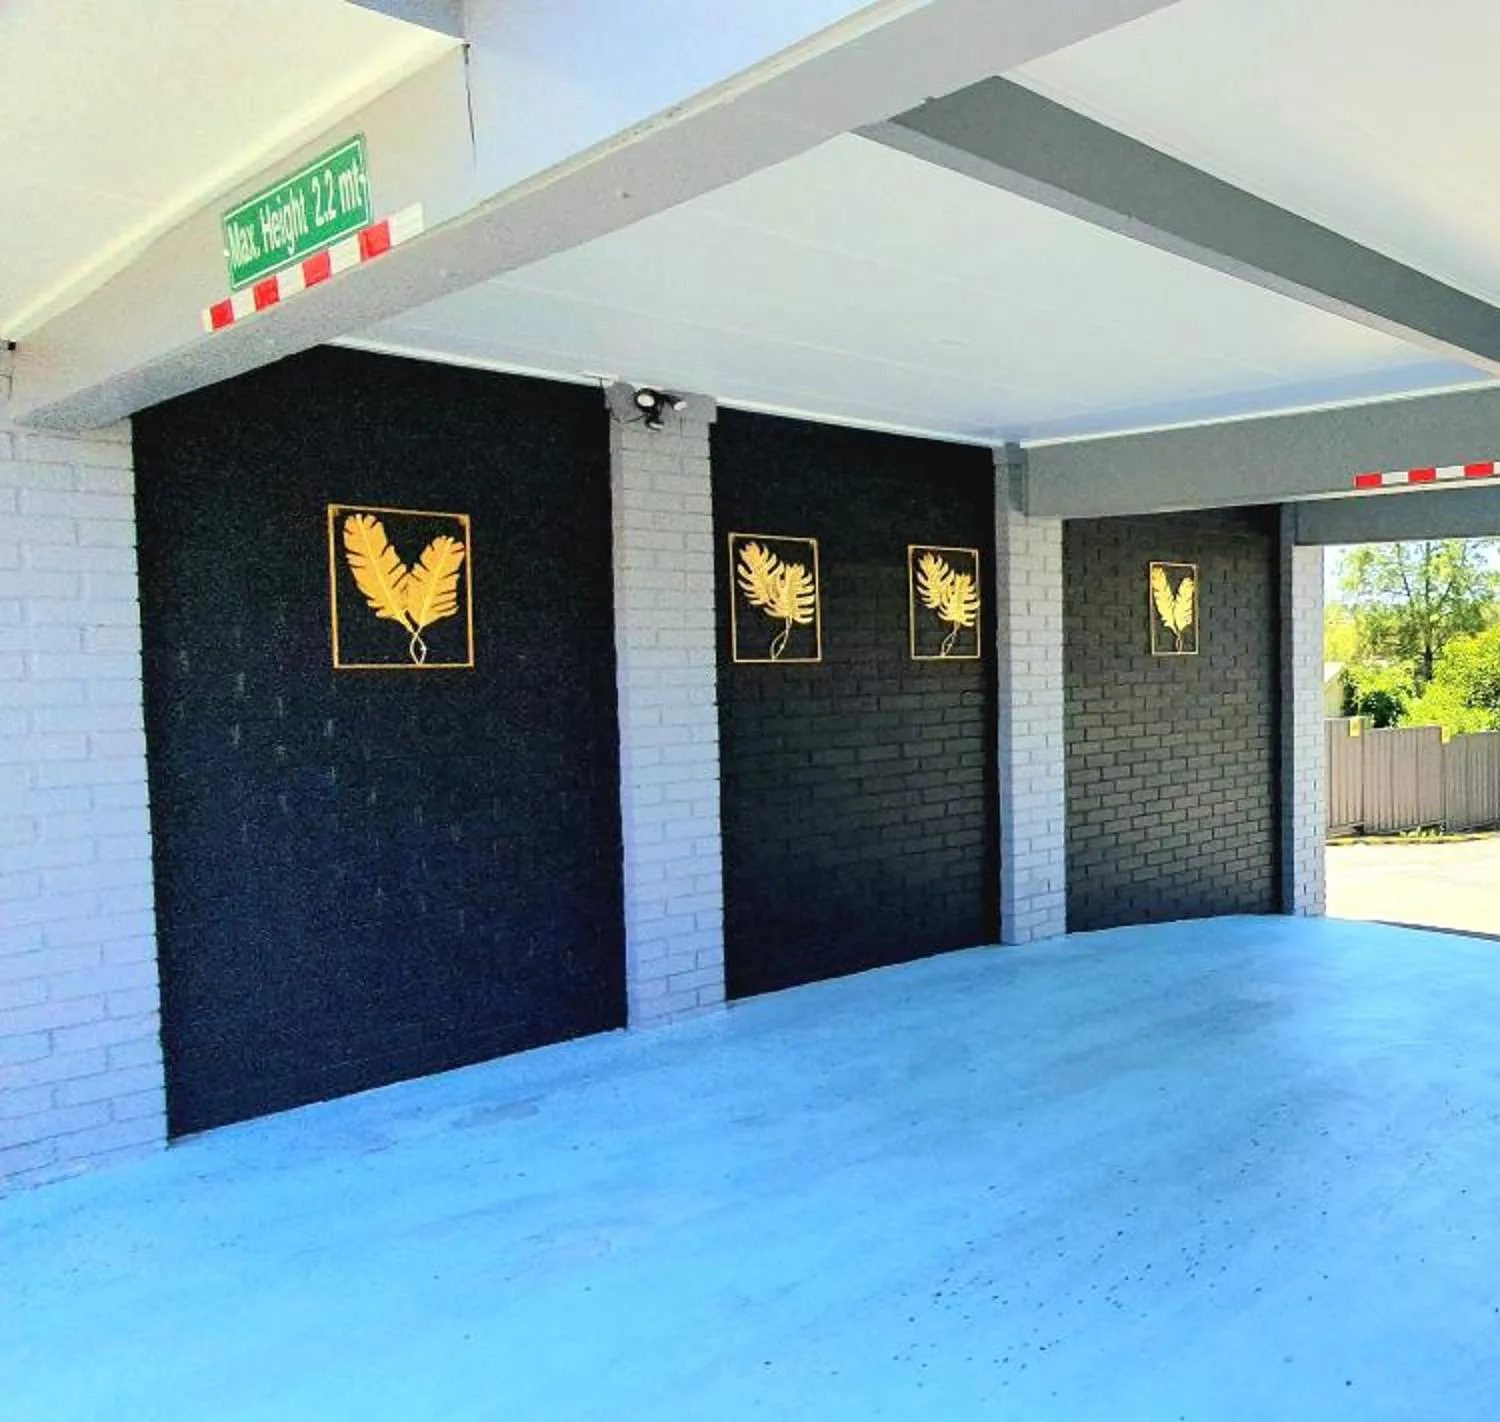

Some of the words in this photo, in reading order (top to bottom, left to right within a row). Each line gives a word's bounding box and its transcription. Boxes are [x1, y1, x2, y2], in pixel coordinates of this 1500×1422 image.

[227, 221, 261, 268] Max.
[259, 187, 308, 256] Height
[312, 169, 336, 227] 2.2
